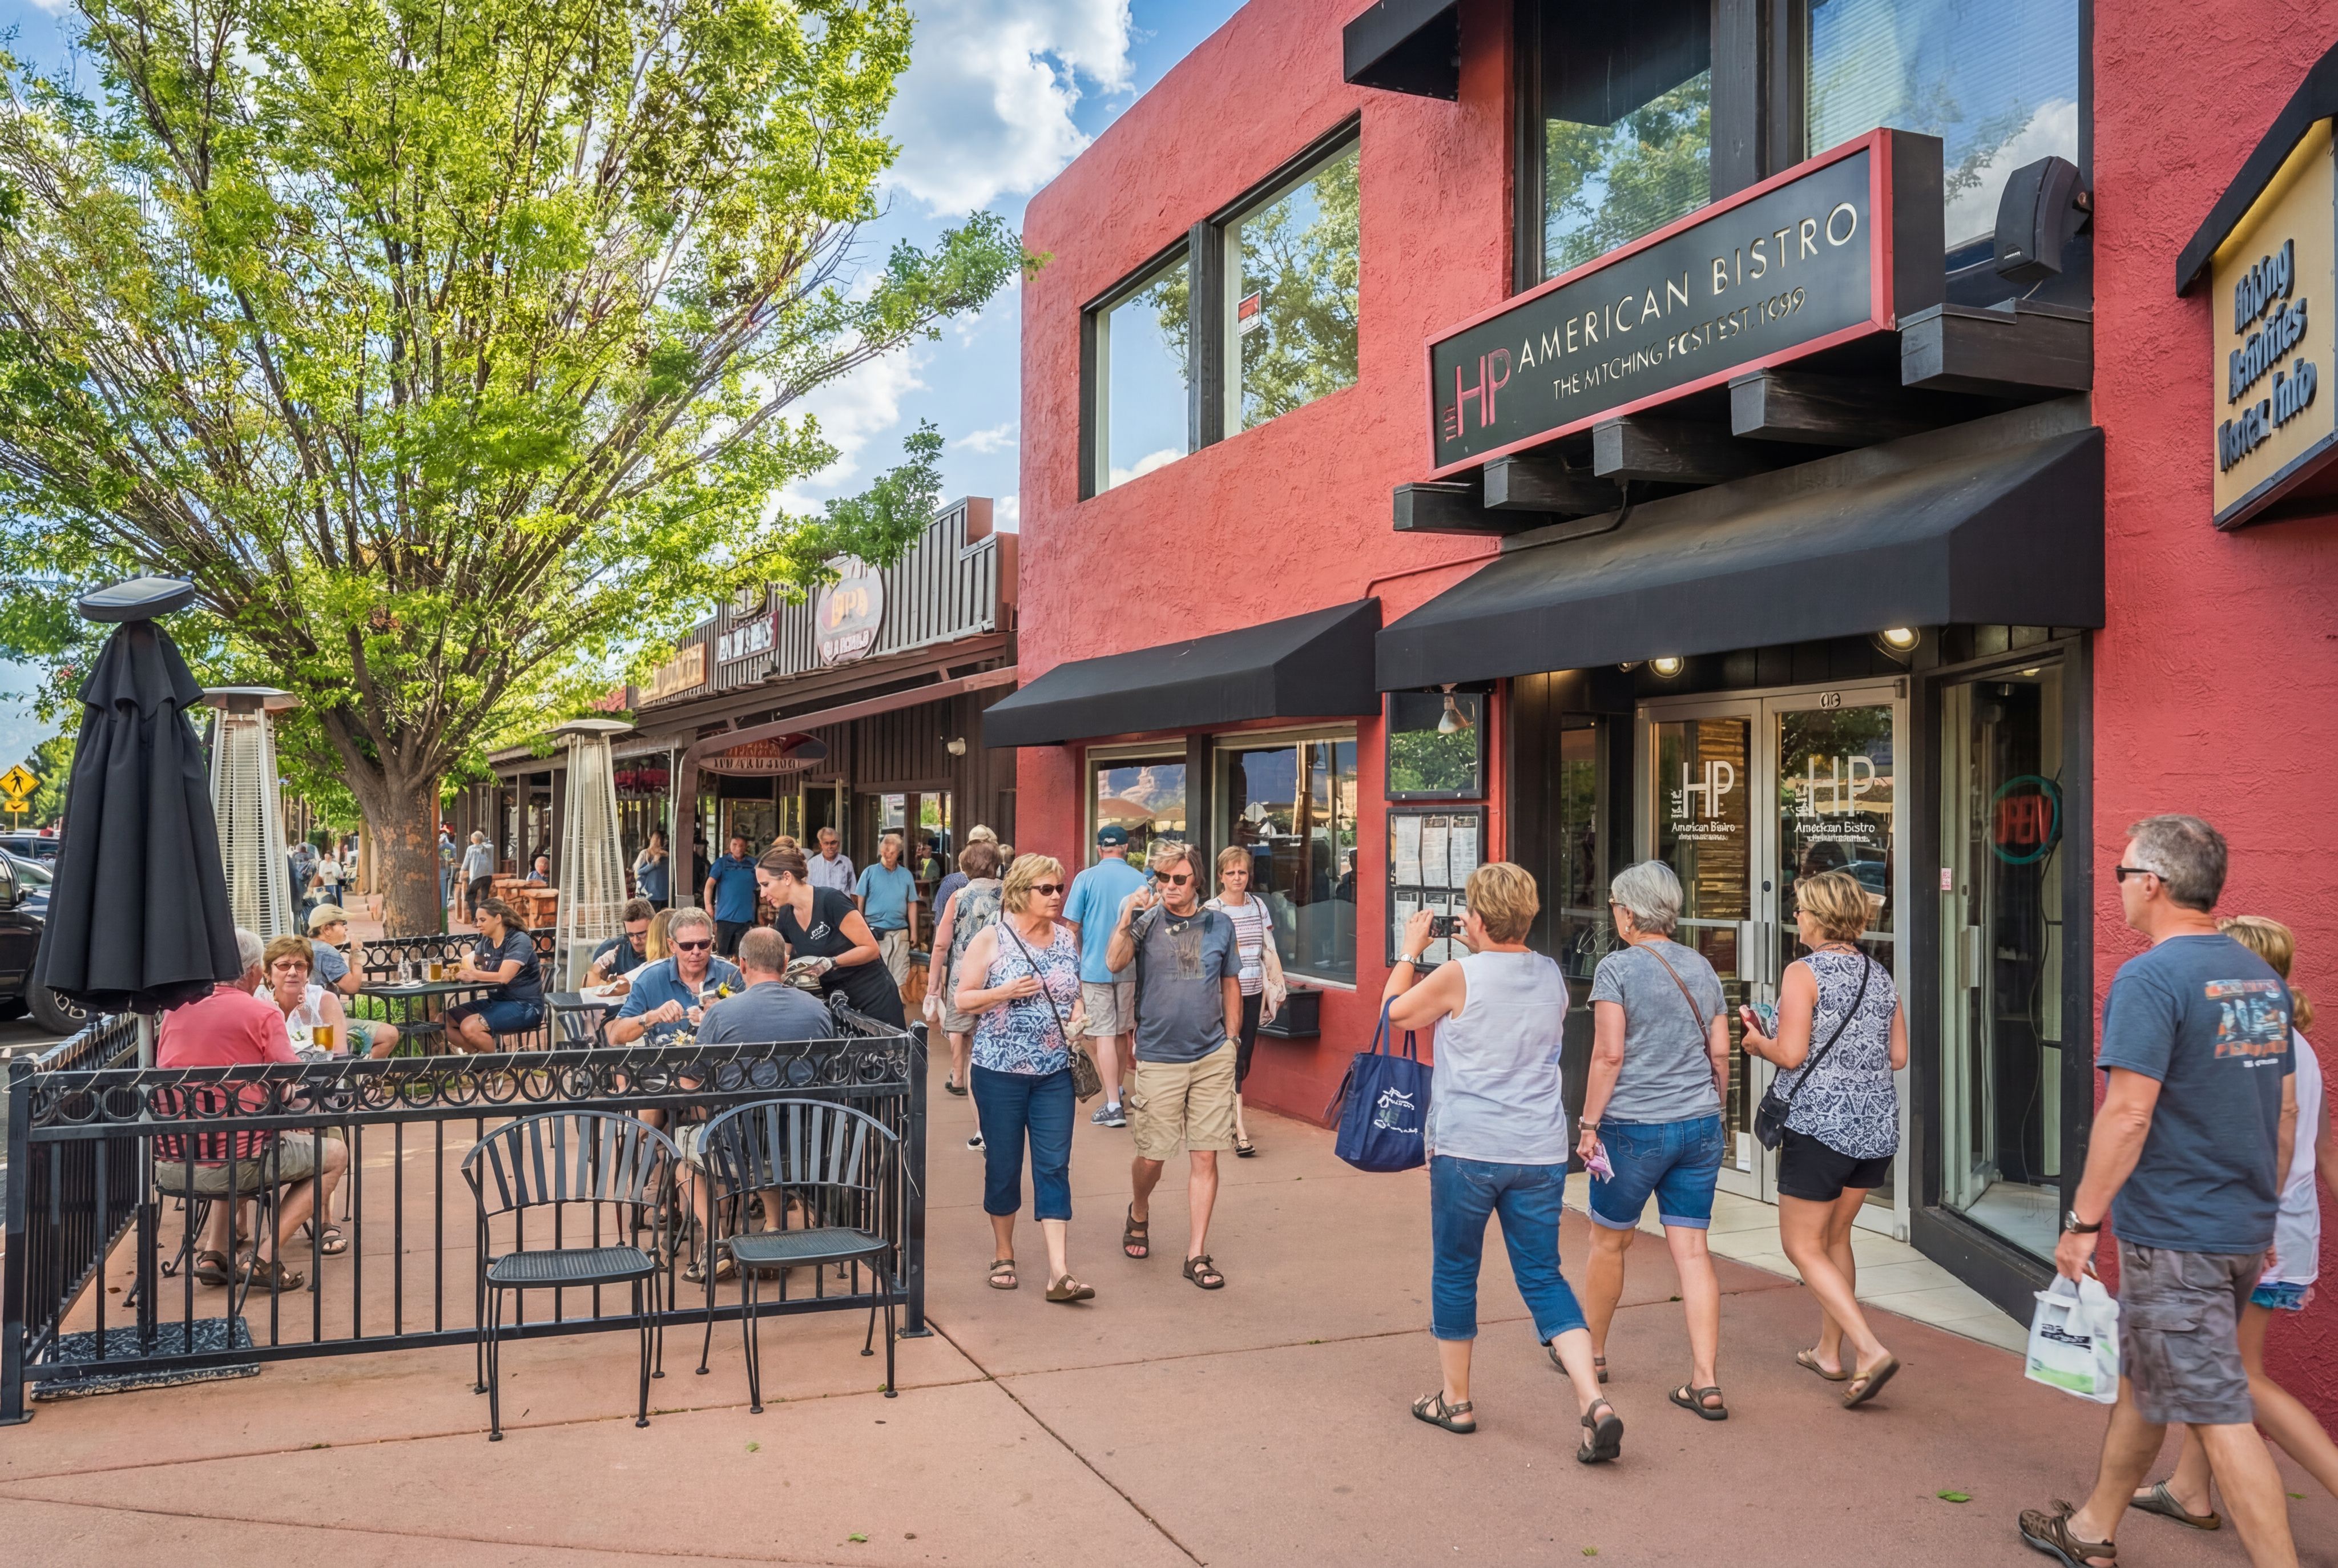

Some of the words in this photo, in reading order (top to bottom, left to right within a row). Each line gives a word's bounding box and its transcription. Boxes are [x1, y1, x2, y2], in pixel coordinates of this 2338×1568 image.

[1518, 270, 1688, 374] AMERICAN
[1711, 202, 1857, 296] BISTRO
[1456, 348, 1511, 437] HP
[1553, 373, 1581, 400] THE
[1683, 760, 1735, 819] HP
[1808, 755, 1876, 817] HP
